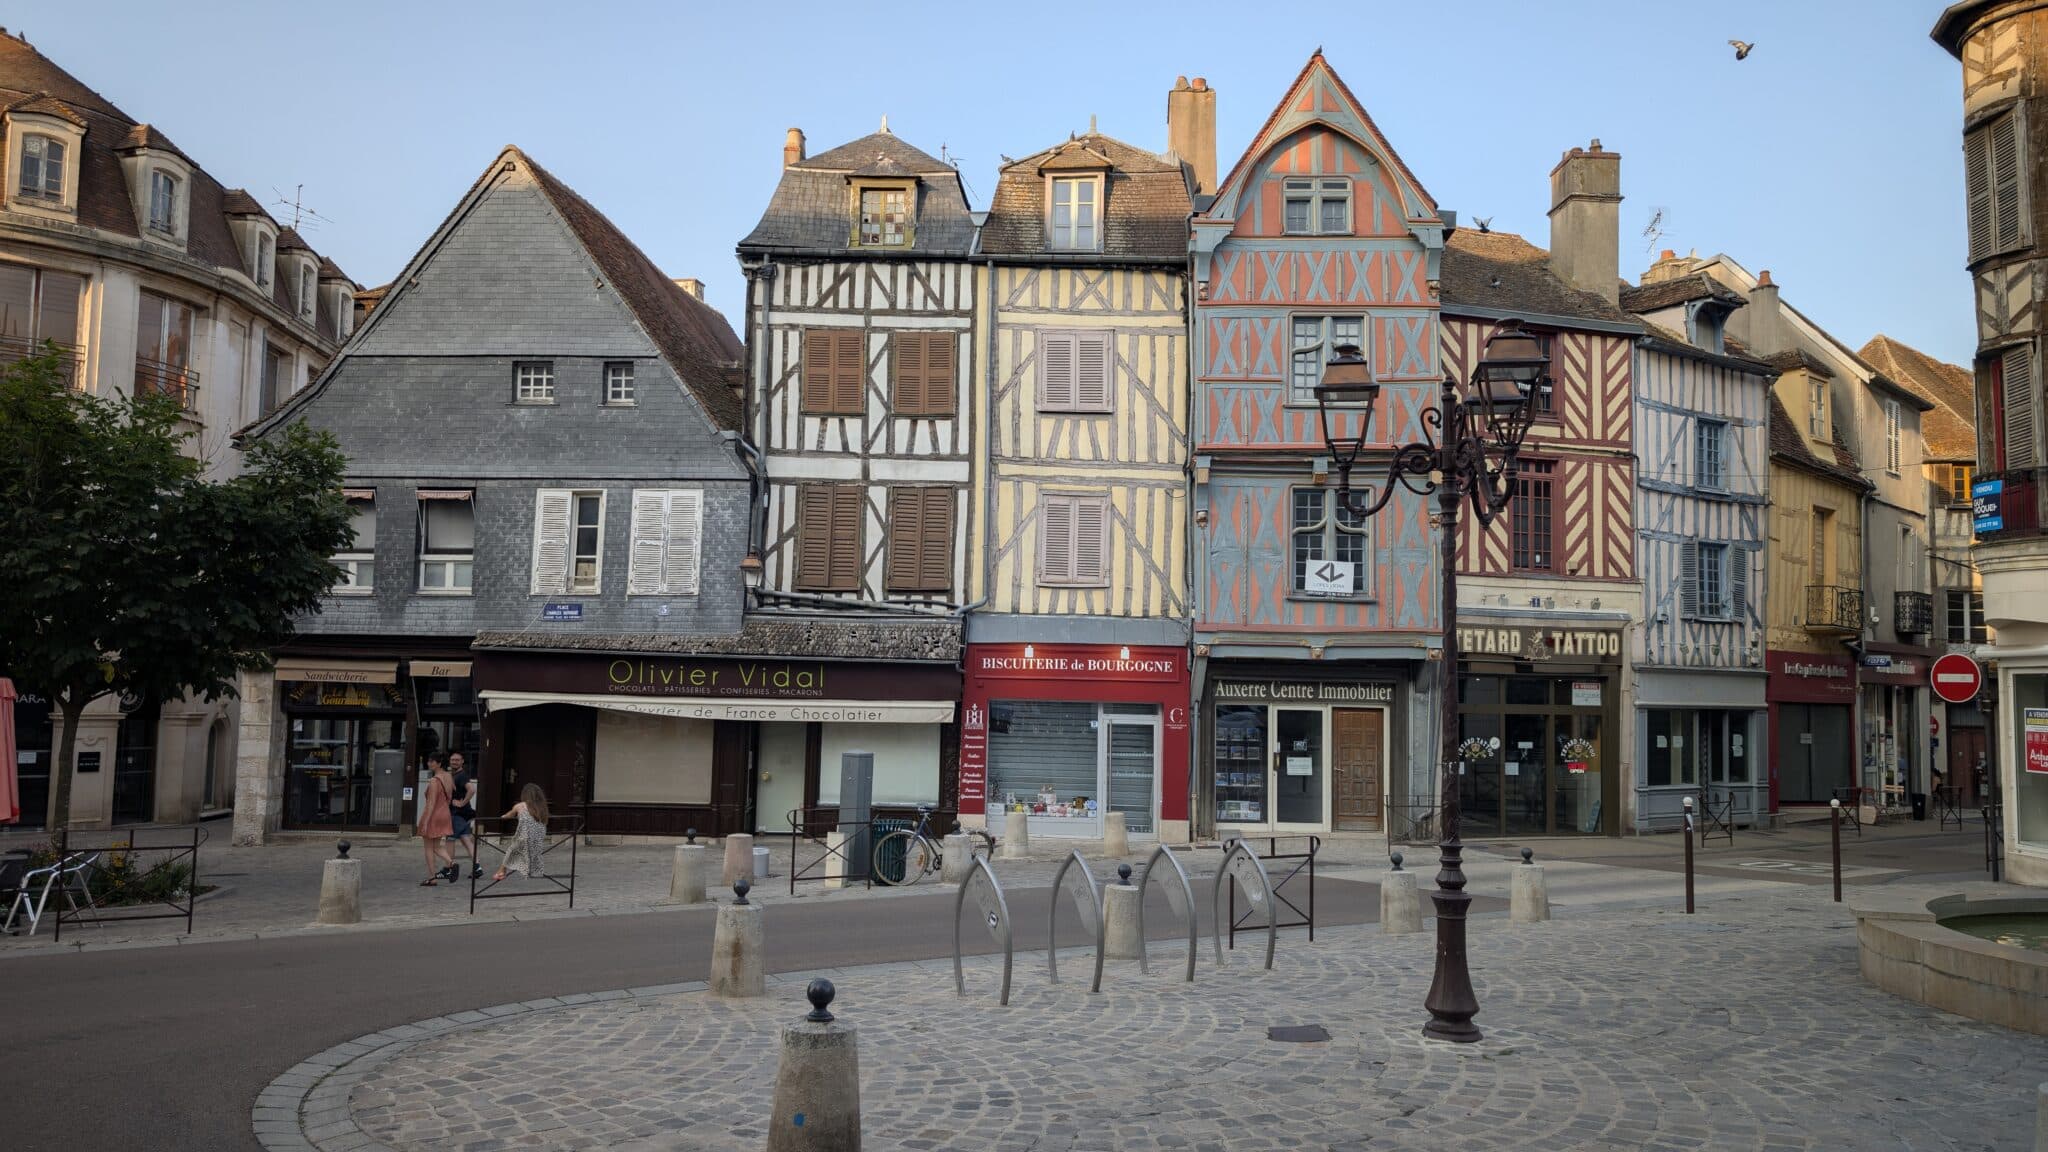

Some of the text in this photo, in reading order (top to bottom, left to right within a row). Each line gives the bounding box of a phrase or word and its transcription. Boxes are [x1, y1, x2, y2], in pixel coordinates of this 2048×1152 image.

[1552, 631, 1619, 656] TATTOO
[431, 665, 451, 677] Bar
[982, 657, 1173, 673] BISCUITERIE de BOURGOGNE
[304, 671, 368, 682] Sandwicherie
[608, 660, 824, 688] Olivier Vidal
[608, 685, 655, 693] CHOCOLATS
[720, 687, 770, 695] CONFISERIES
[779, 689, 824, 697] MACARONS
[1215, 680, 1393, 700] Auxerre Centre Immobilier
[693, 706, 713, 718] de
[726, 706, 777, 719] France
[790, 708, 883, 721] Chocolatier
